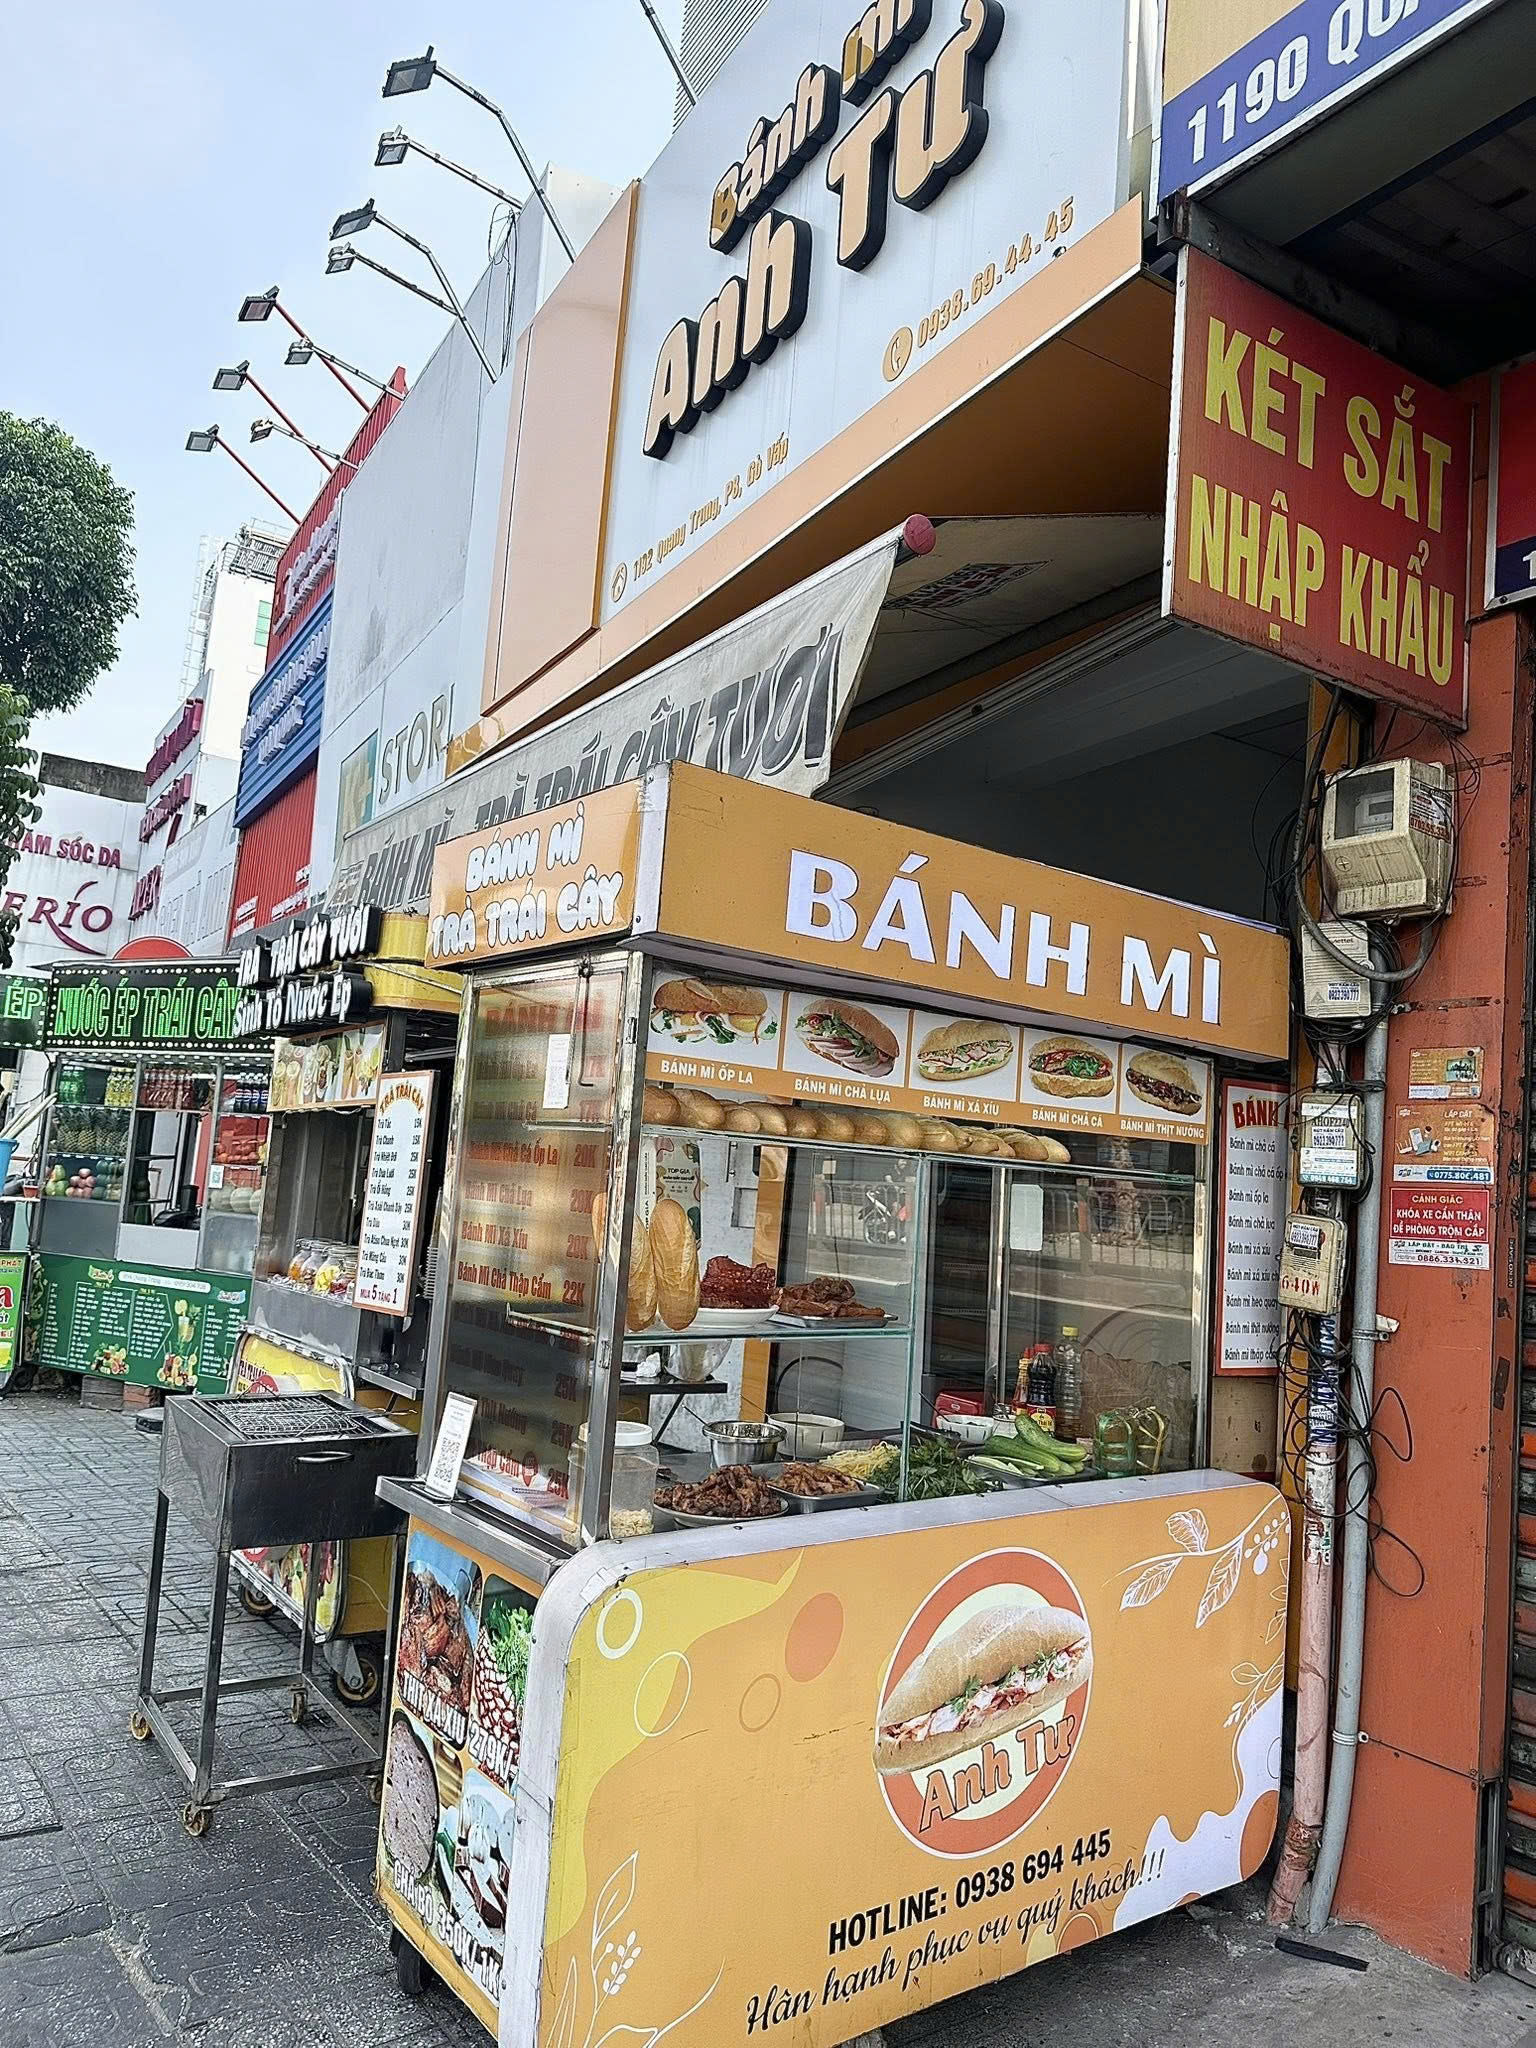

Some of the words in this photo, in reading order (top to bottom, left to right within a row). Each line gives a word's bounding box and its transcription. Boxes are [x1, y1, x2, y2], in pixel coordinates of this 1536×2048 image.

[1187, 35, 1309, 164] 1190
[1328, 0, 1420, 66] QU
[709, 62, 840, 254] Bánh
[643, 209, 813, 459] Anh
[827, 0, 1004, 271] Tư
[917, 195, 1074, 348] 0938.69.44.45
[1204, 316, 1326, 470] KÉT
[1343, 384, 1452, 534] SẮT
[657, 523, 687, 564] Quang
[747, 454, 763, 488] Gò
[1188, 473, 1326, 642] NHẬP
[1339, 540, 1454, 686] KHẨU
[57, 836, 94, 863] SÓC
[98, 847, 121, 869] DA
[465, 827, 541, 893] BÁNH
[546, 801, 585, 870] MÌ
[431, 895, 477, 959] TRÀ
[485, 878, 547, 948] TRÁI
[556, 864, 623, 933] CÂY
[785, 848, 1090, 997] BÁNH
[1120, 932, 1222, 1025] MÌ
[54, 977, 110, 1038] NƯỚC
[111, 977, 140, 1038] ÉP
[142, 976, 195, 1039] TRÁI
[195, 977, 243, 1039] CÂY
[232, 993, 263, 1040] Sinh
[661, 1059, 697, 1077] BÁNH
[700, 1066, 714, 1079] MÌ
[718, 1064, 736, 1082] ỐP
[738, 1070, 753, 1084] LA
[795, 1077, 826, 1093] BÁNH
[829, 1081, 842, 1096] MÌ
[845, 1083, 867, 1100] CHẢ
[869, 1087, 891, 1103] LỤA
[923, 1095, 951, 1110] BÁNH
[953, 1097, 965, 1112] MÌ
[967, 1097, 981, 1113] XÁ
[981, 1099, 999, 1116] XÍU
[1032, 1108, 1060, 1123] BÁNH
[1062, 1111, 1070, 1124] MÌ
[1071, 1111, 1090, 1126] CHẢ
[1091, 1114, 1103, 1128] CÁ
[1121, 1118, 1143, 1132] BÁNH
[1145, 1121, 1155, 1133] MÌ
[1156, 1122, 1176, 1138] THỊT
[1233, 1096, 1279, 1129] BÁNH
[533, 1137, 546, 1167] Ốp
[547, 1145, 560, 1165] La
[1230, 1136, 1245, 1150] Bánh
[1246, 1138, 1254, 1150] mì
[1255, 1138, 1266, 1152] chả
[1267, 1140, 1275, 1152] cá
[1229, 1163, 1244, 1175] Bánh
[1245, 1164, 1253, 1176] mì
[1254, 1164, 1265, 1178] chả
[1266, 1166, 1275, 1178] cá
[1229, 1189, 1244, 1201] Bánh
[1245, 1190, 1253, 1202] mì
[1254, 1188, 1262, 1205] ốp
[1263, 1192, 1269, 1203] la
[1412, 1193, 1437, 1204] CẢNH
[1439, 1193, 1463, 1205] GIÁC
[1229, 1216, 1244, 1227] Bánh
[1244, 1216, 1252, 1228] mì
[1253, 1216, 1265, 1229] chả
[1393, 1220, 1404, 1233] ĐỂ
[1406, 1222, 1436, 1235] PHÒNG
[1438, 1224, 1463, 1239] TRỘM
[1465, 1223, 1485, 1238] CẮP
[1396, 1207, 1420, 1219] KHÓA
[1422, 1210, 1433, 1218] XE
[1435, 1206, 1454, 1220] CẨN
[1454, 1209, 1481, 1223] THẬN
[461, 1220, 482, 1242] Bánh
[484, 1224, 496, 1245] Mì
[498, 1226, 510, 1247] Xá
[512, 1228, 528, 1250] Xíu
[566, 1233, 590, 1260] 20K
[1228, 1242, 1243, 1254] Bánh
[1244, 1243, 1252, 1254] mì
[1253, 1243, 1261, 1255] xá
[1261, 1244, 1271, 1256] xíu
[458, 1261, 477, 1283] Bánh
[478, 1265, 489, 1286] Mì
[491, 1267, 507, 1290] Chả
[509, 1271, 530, 1298] Thập
[531, 1272, 552, 1299] Cẩm
[562, 1279, 586, 1307] 22K
[1227, 1269, 1242, 1280] Bánh
[1243, 1270, 1251, 1281] mì
[1252, 1269, 1260, 1281] xá
[1261, 1270, 1270, 1281] xíu
[372, 1284, 377, 1300] 5
[392, 1287, 398, 1304] 1
[1226, 1295, 1243, 1307] Bánh
[1243, 1296, 1250, 1306] mì
[1251, 1297, 1263, 1307] heo
[1225, 1322, 1241, 1334] Bánh
[1242, 1323, 1250, 1333] mì
[1251, 1323, 1260, 1336] thịt
[918, 1742, 1010, 1833] Anh
[1016, 1713, 1076, 1777] Tư
[828, 1885, 948, 1955] HOTLINE:
[954, 1861, 1015, 1911] 0938
[1022, 1847, 1064, 1885] 694
[1071, 1828, 1112, 1868] 445
[746, 1983, 818, 2035] Hân
[822, 1945, 901, 2007] hạnh
[902, 1929, 972, 1991] phục
[978, 1911, 1012, 1947] vụ
[1017, 1887, 1066, 1947] quý
[1069, 1848, 1166, 1912] khách!!!
